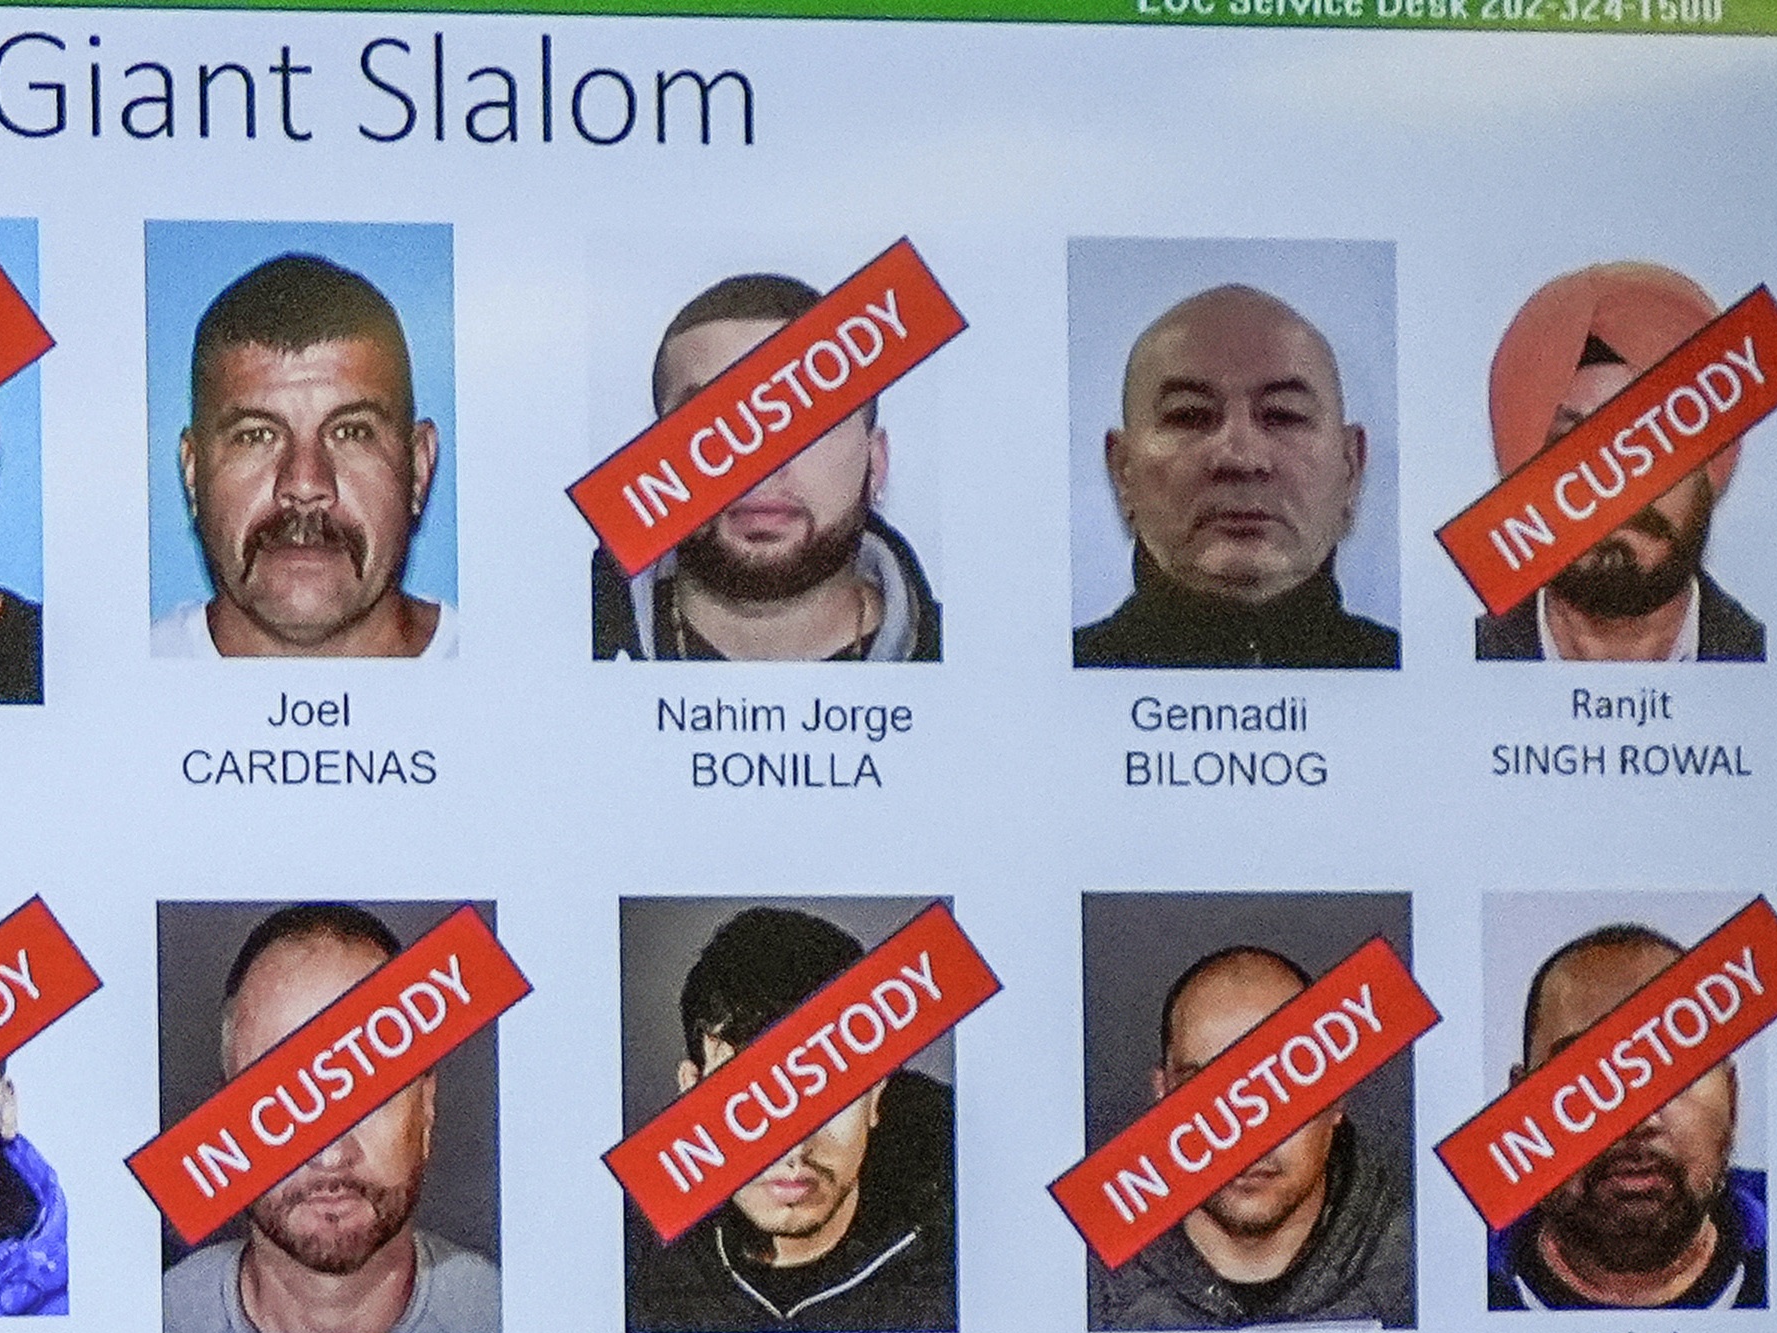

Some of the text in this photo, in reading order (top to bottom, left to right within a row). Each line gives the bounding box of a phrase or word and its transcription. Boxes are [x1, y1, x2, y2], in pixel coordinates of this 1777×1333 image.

[1375, 0, 1469, 21] Desk
[357, 30, 755, 147] Slalom
[622, 288, 908, 528] IN CUSTODY
[1490, 336, 1764, 570] IN CUSTODY
[267, 691, 351, 728] Joel
[657, 696, 913, 739] Nahim Jorge
[1130, 695, 1307, 732] Gennadii
[1571, 687, 1673, 728] Ranjit
[181, 748, 438, 786] CARDENAS
[691, 751, 883, 789] BONILLA
[1125, 750, 1328, 787] BILONOG
[1491, 743, 1753, 778] SINGH ROWAL
[182, 954, 471, 1198] IN CUSTODY
[658, 950, 942, 1193] IN CUSTODY
[1489, 948, 1764, 1184] IN CUSTODY
[1102, 983, 1382, 1223] IN CUSTODY
